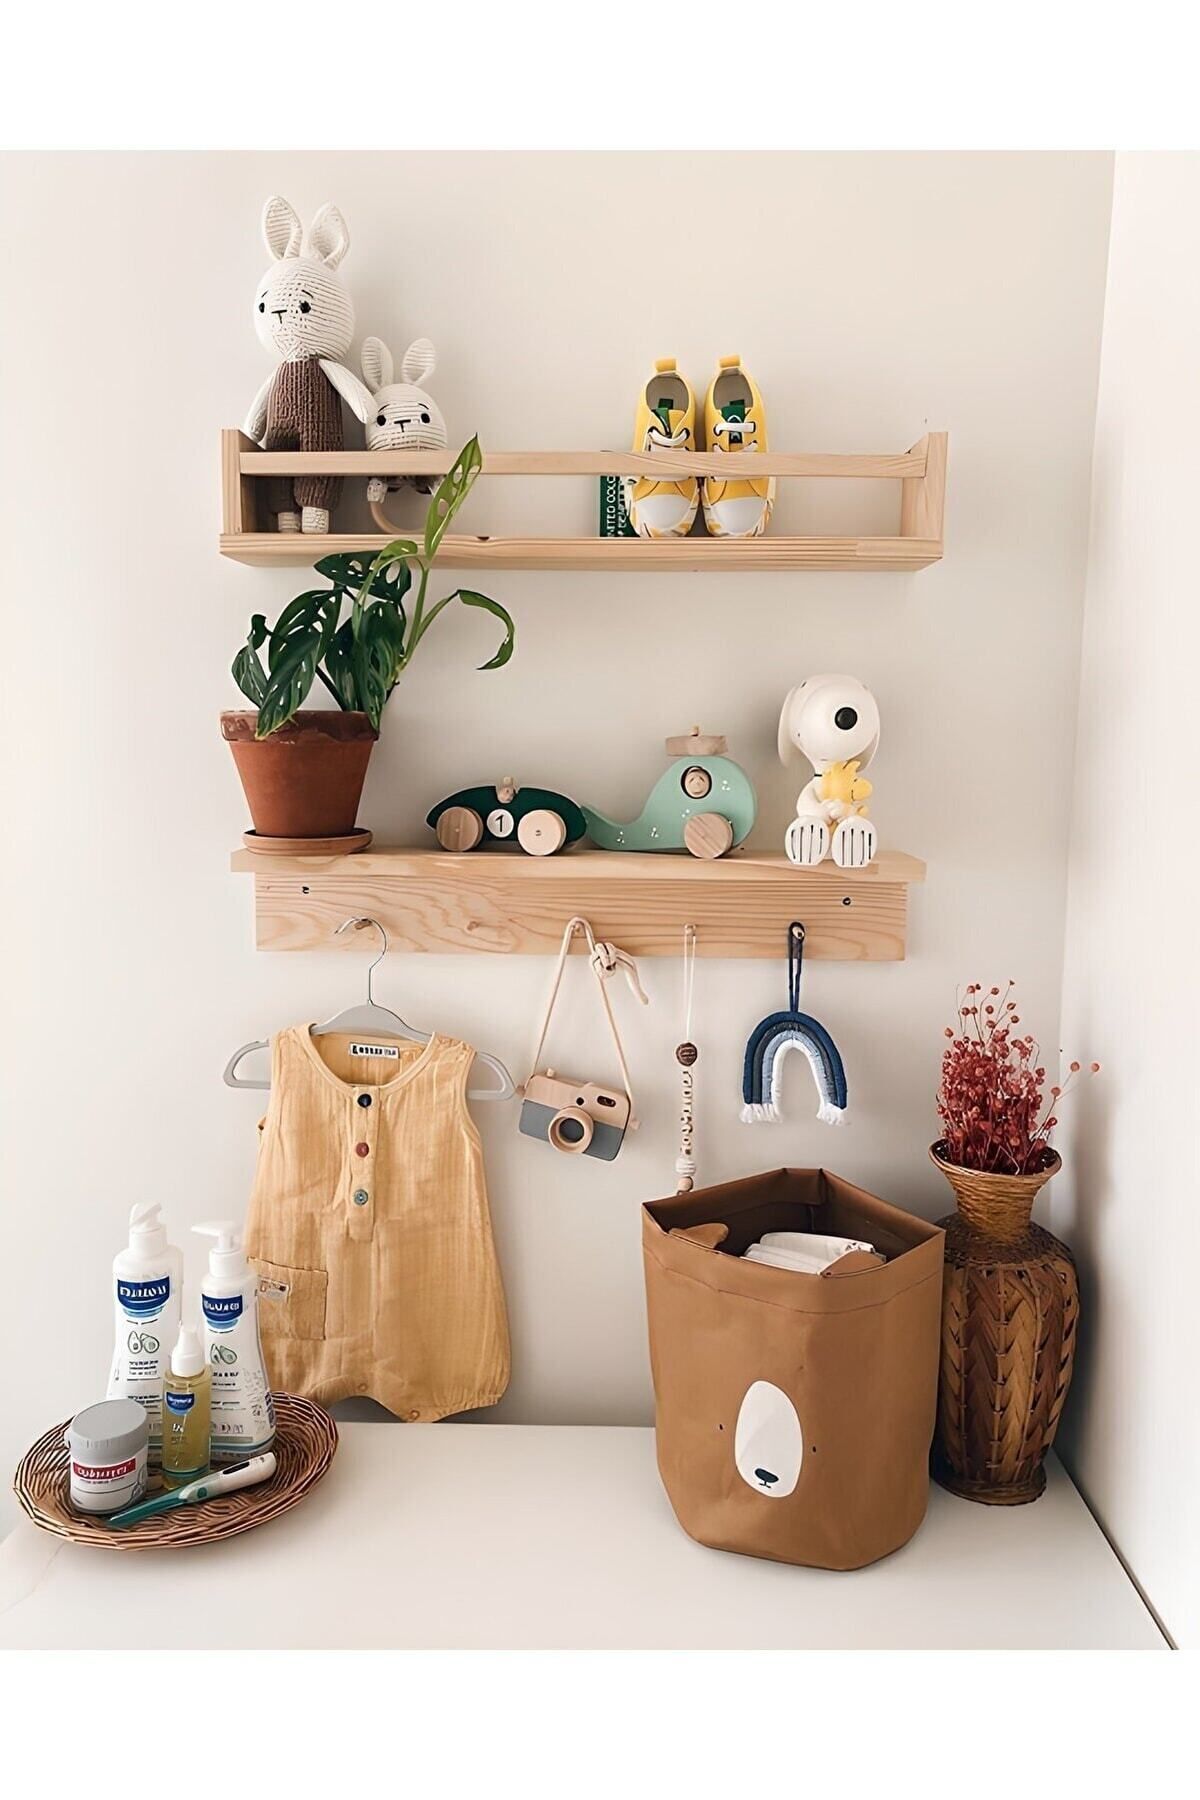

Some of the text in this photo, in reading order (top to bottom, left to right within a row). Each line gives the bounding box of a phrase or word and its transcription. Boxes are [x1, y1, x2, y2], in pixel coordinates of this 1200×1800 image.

[606, 475, 616, 537] NITED COLO
[495, 814, 504, 833] 1
